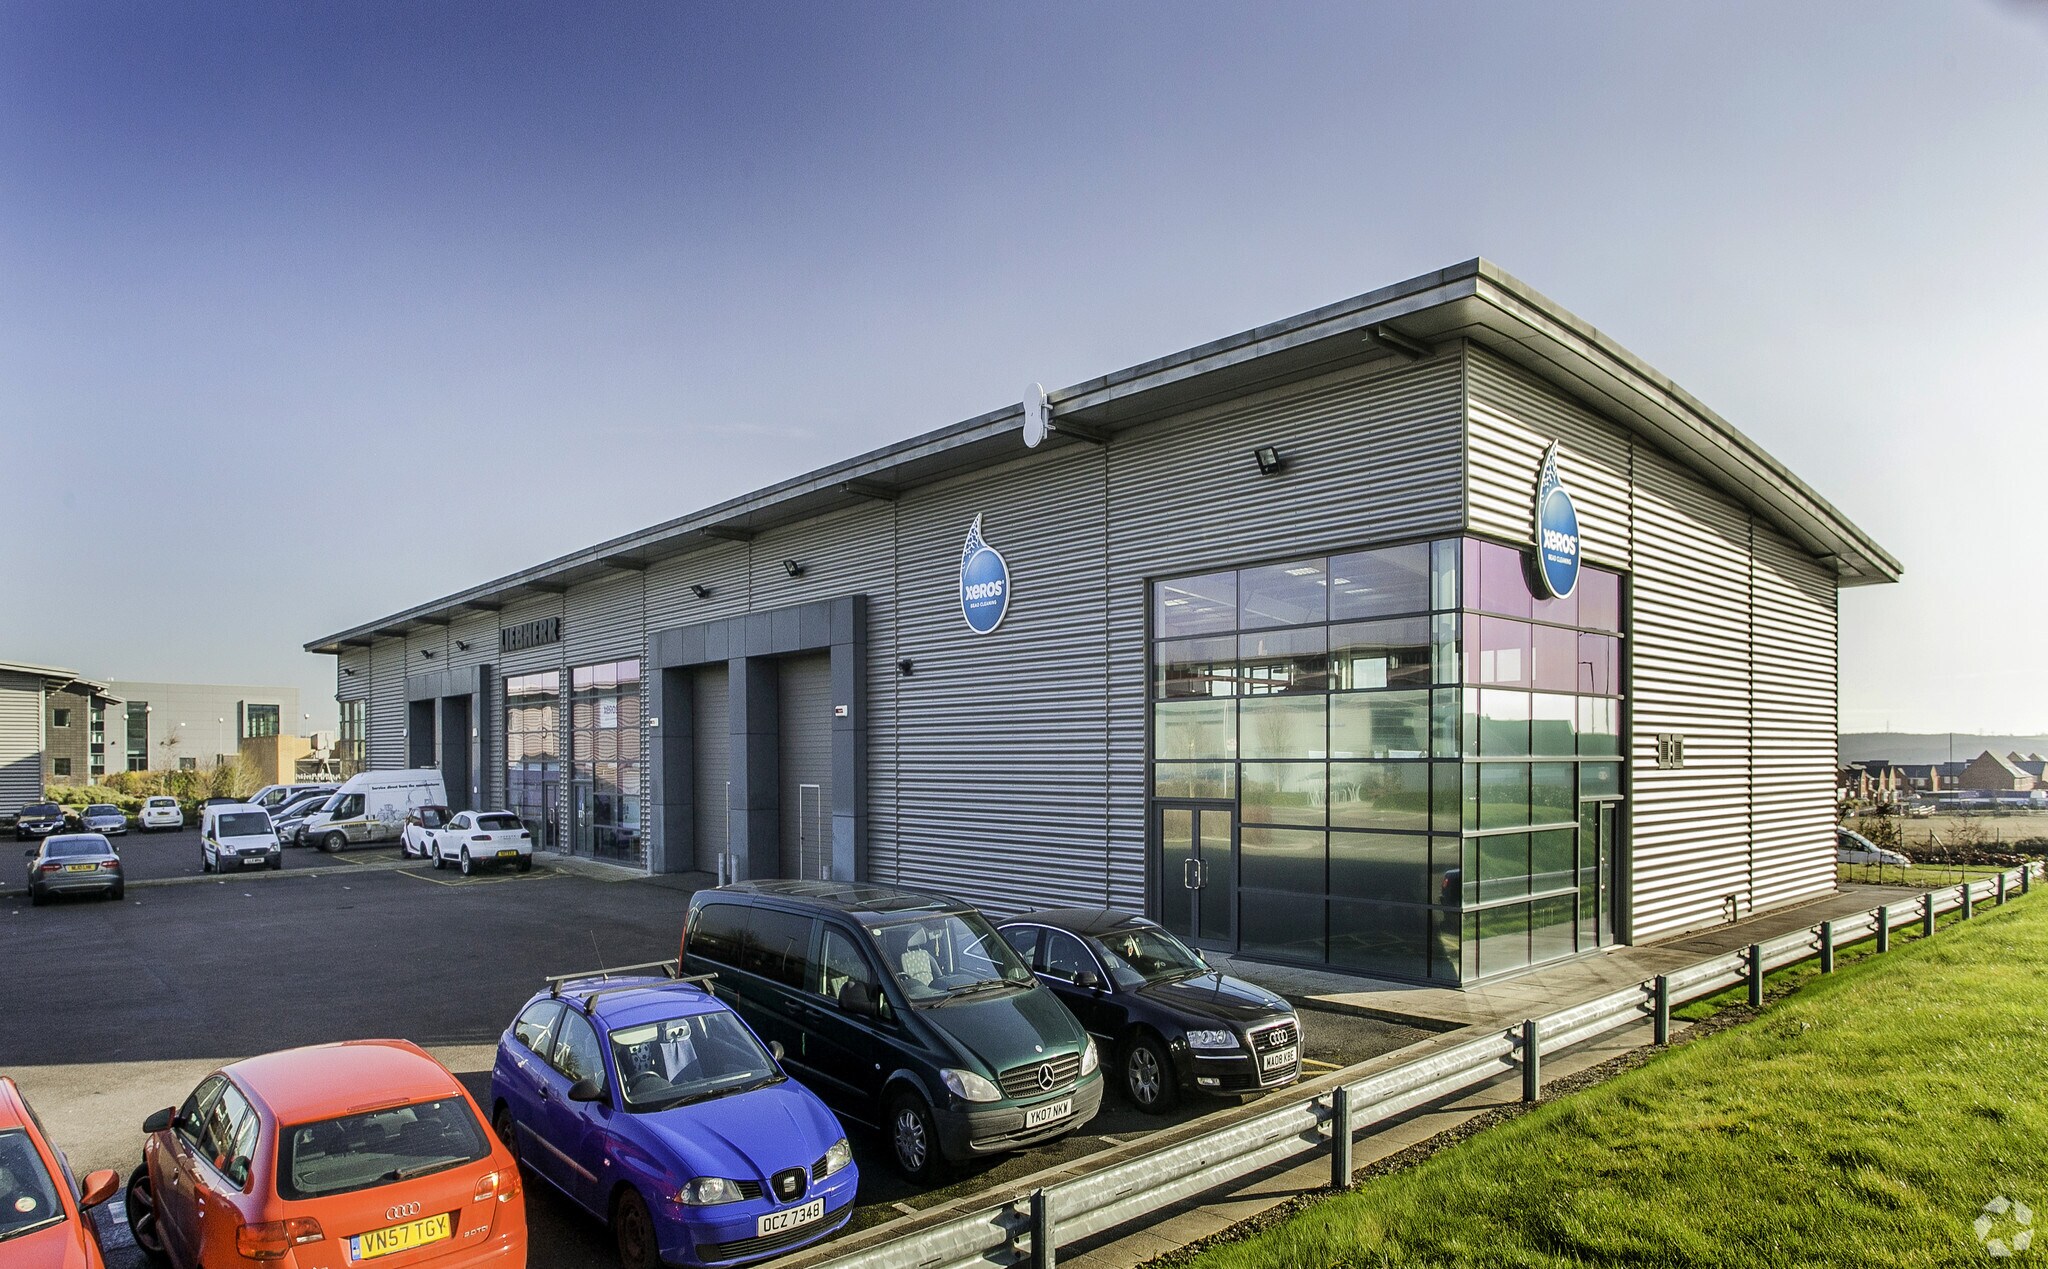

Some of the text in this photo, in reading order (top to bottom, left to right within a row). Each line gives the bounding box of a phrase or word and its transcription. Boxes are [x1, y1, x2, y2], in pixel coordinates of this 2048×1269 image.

[980, 599, 997, 608] CLEANING
[500, 617, 558, 653] LIEBHERR
[1283, 1049, 1294, 1062] KBE
[1030, 1101, 1069, 1124] YK07 NKW
[763, 1202, 820, 1232] OCZ 7348
[364, 1216, 445, 1252] VN57 TGY
